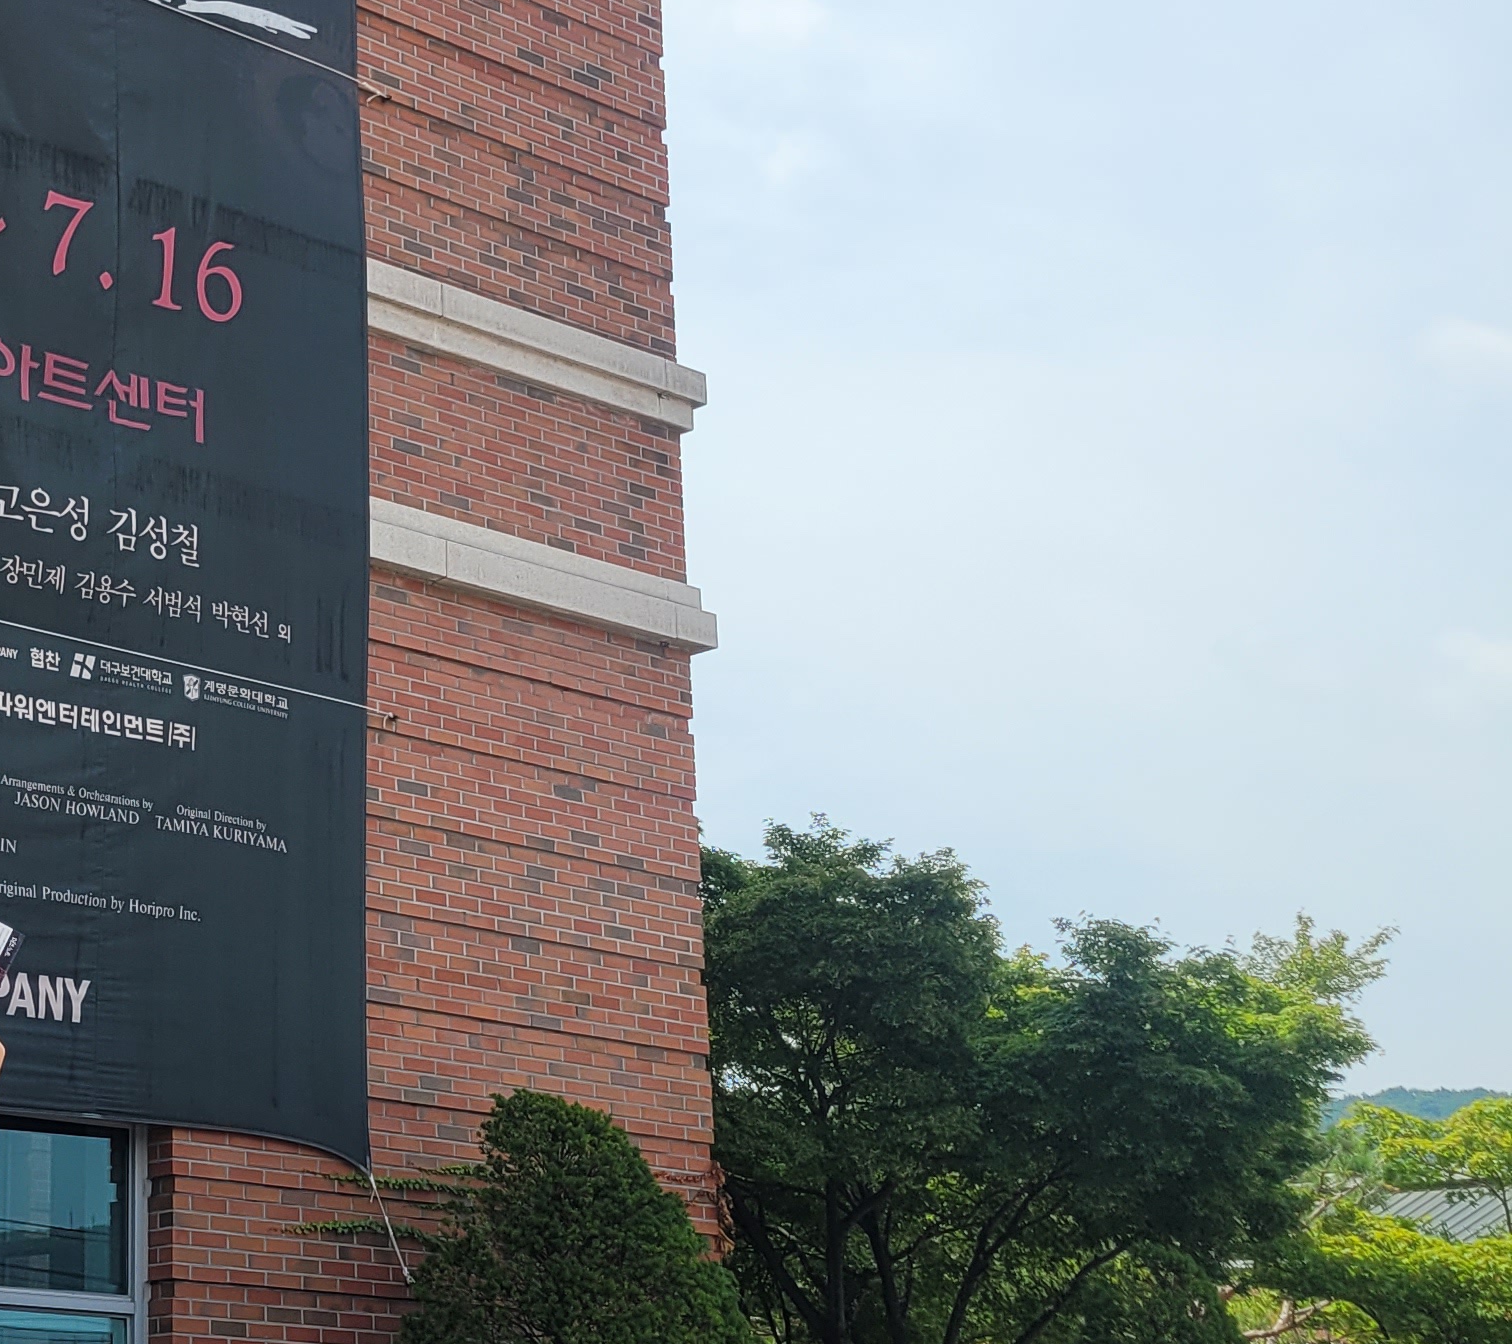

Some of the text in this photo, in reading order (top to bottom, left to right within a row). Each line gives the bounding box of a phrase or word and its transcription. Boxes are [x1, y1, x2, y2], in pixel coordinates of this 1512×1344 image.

[43, 191, 116, 291] 7.
[151, 225, 245, 324] 16
[105, 507, 201, 569] 김성철
[0, 554, 66, 595] 장민제
[74, 570, 138, 608] 김용수
[143, 586, 202, 624] 서범석
[211, 600, 270, 639] 박현선
[276, 623, 292, 645] 외
[29, 646, 62, 672] 협찬
[99, 659, 173, 686] 대구보건대학교
[203, 679, 289, 710] 계명문화대학교
[0, 773, 154, 812] Arrangements & Orchestrations by
[13, 790, 141, 826] JASON HOWLAND
[154, 814, 288, 854] TAMIYA KURIYAMA
[175, 804, 267, 833] Original Direction by
[41, 885, 108, 910] Production
[110, 895, 126, 914] by
[128, 898, 176, 920] Horipro
[178, 904, 202, 923] Inc.
